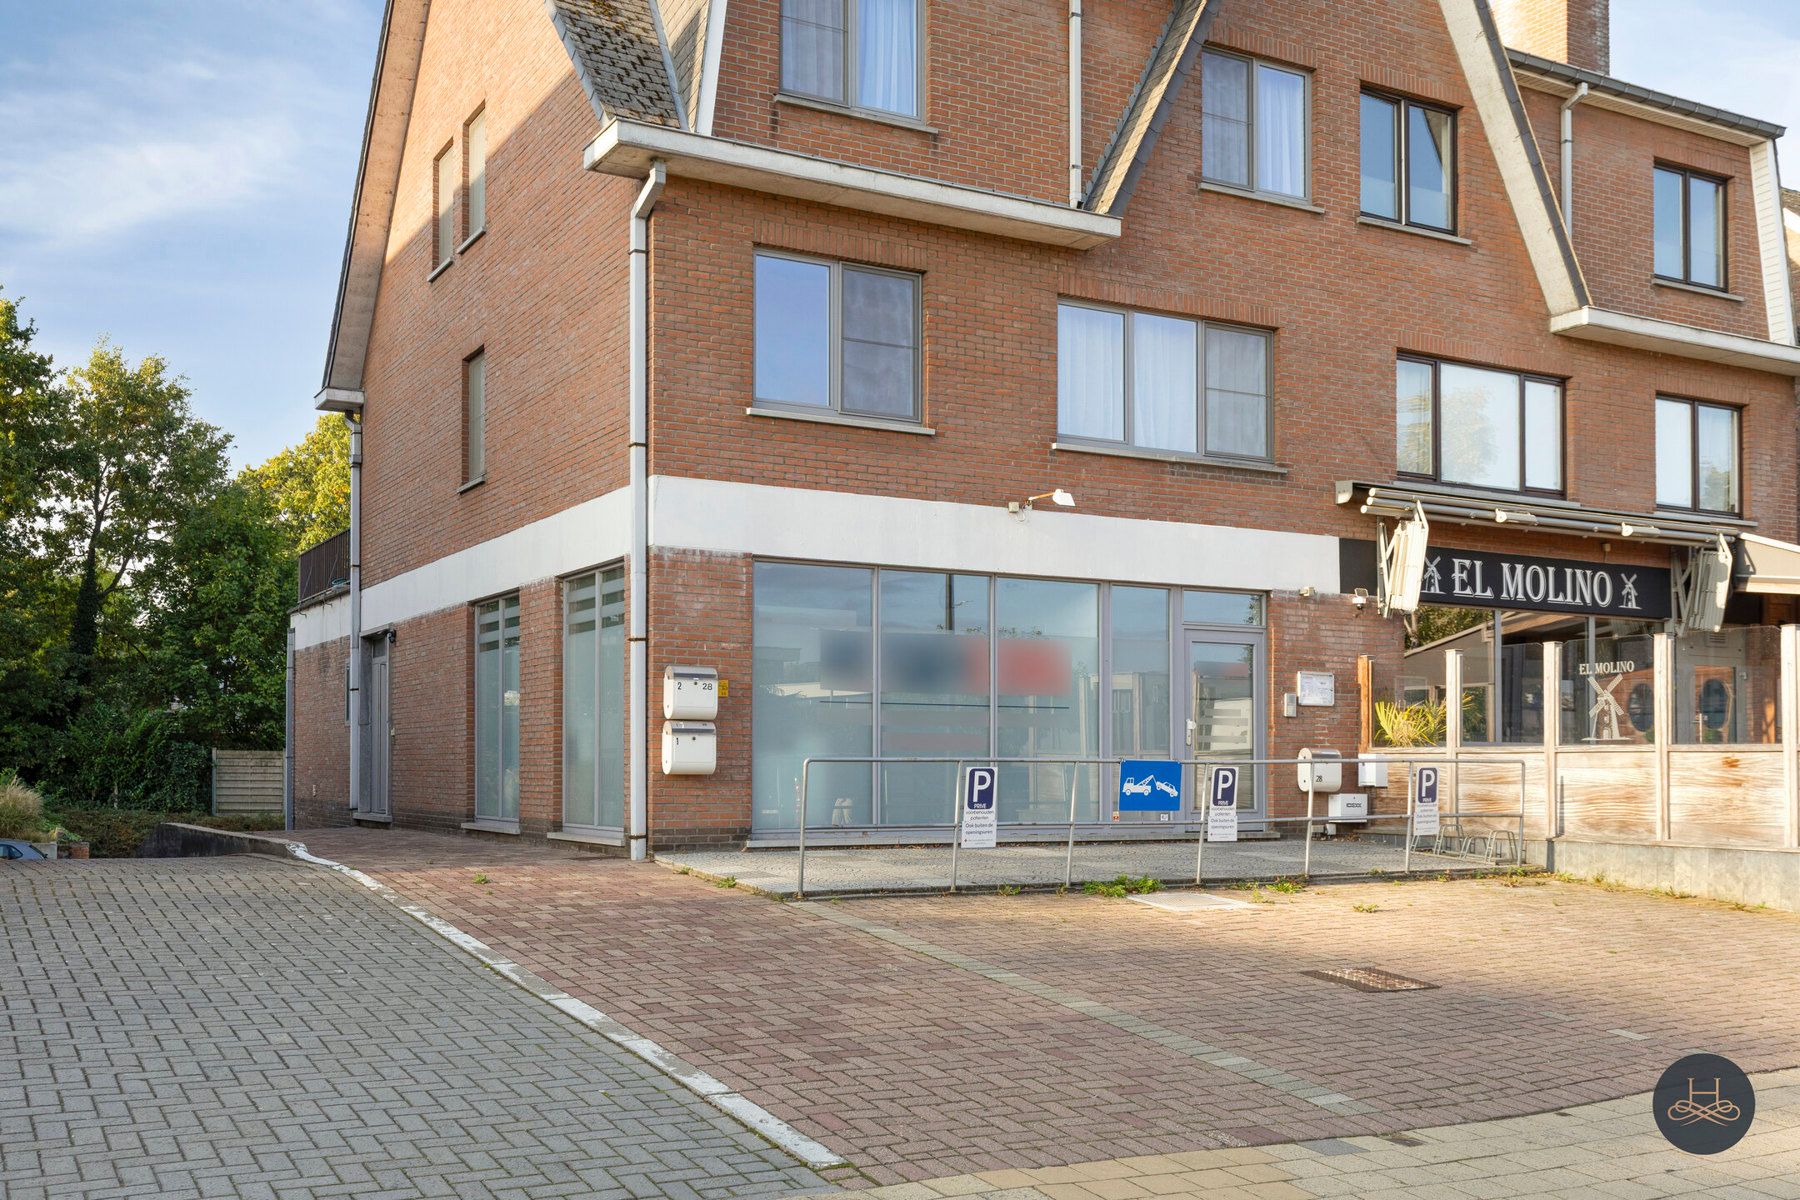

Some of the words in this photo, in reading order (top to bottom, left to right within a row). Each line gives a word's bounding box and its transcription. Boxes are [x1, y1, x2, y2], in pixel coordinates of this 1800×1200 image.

[1451, 558, 1494, 599] EL
[1500, 562, 1613, 607] MOLINO
[1579, 663, 1592, 675] EL
[1594, 660, 1635, 674] MOLINO
[677, 682, 682, 690] 2
[702, 682, 713, 691] 28
[973, 771, 991, 802] P
[1217, 771, 1233, 799] P
[1315, 775, 1323, 783] 28
[1421, 769, 1435, 797] P
